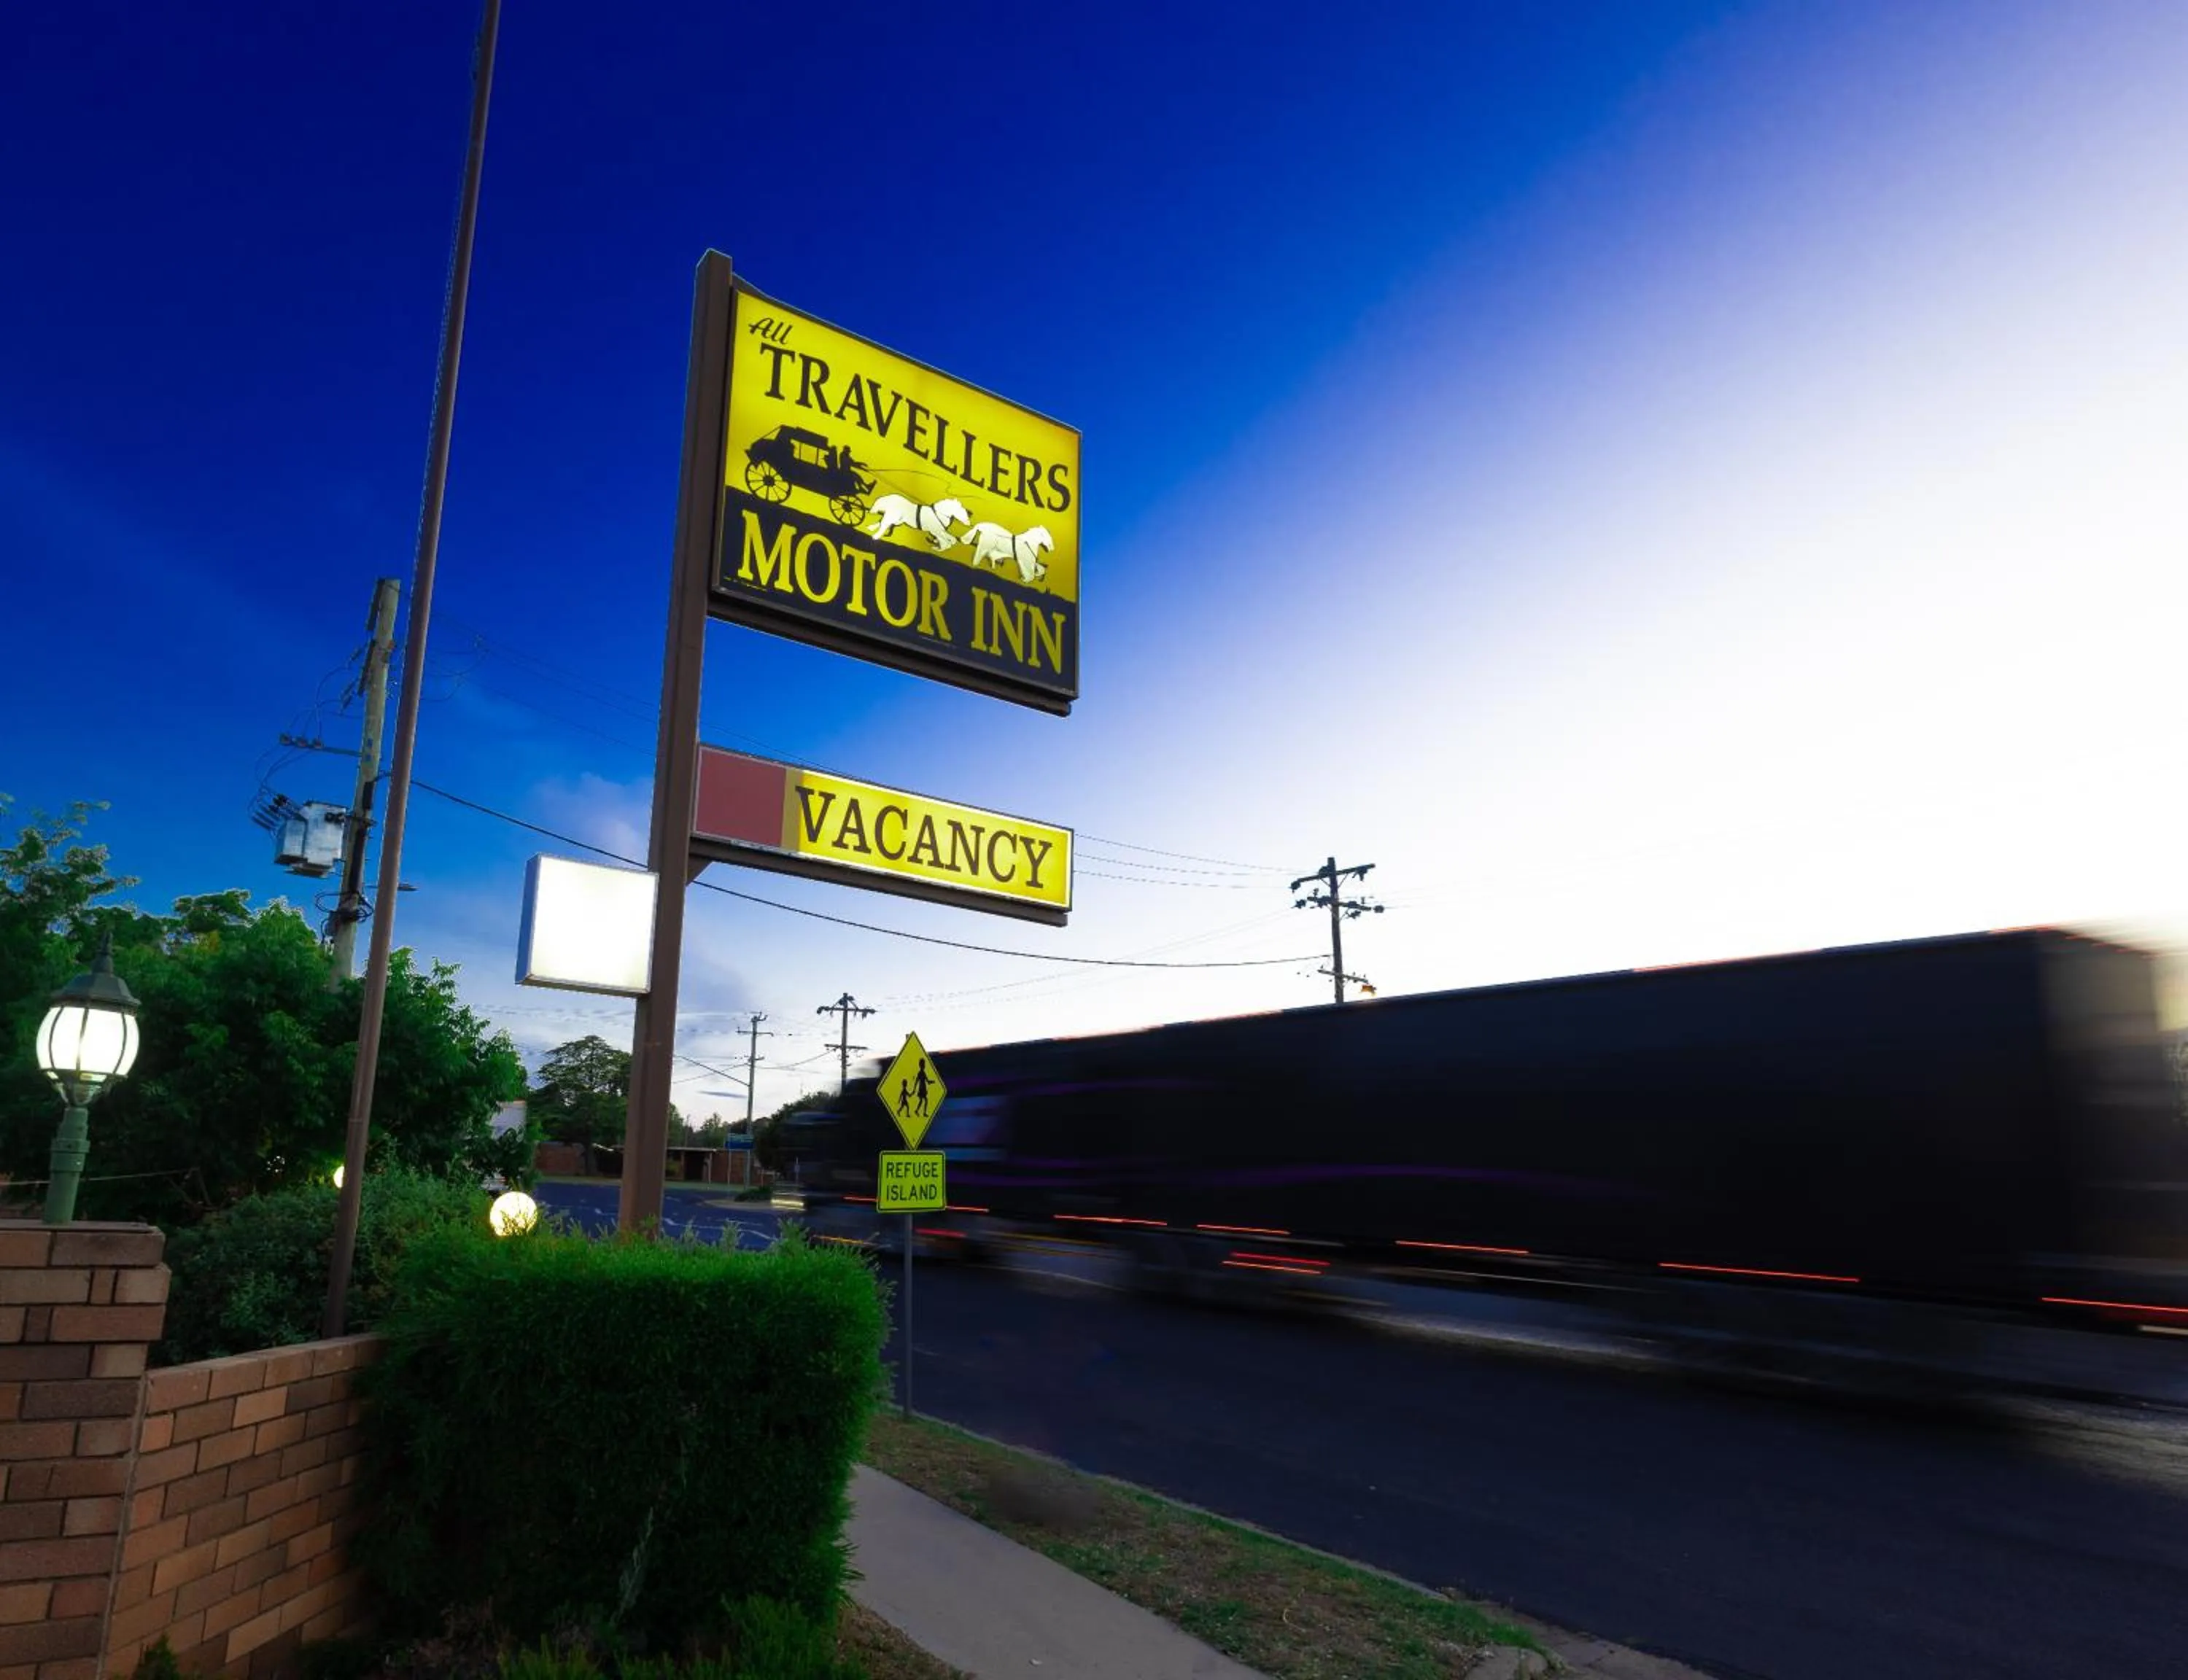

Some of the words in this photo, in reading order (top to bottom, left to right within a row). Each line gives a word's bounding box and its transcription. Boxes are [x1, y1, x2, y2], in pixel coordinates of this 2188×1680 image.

[748, 316, 792, 345] All
[760, 343, 1071, 512] TRAVELLERS
[737, 509, 952, 640] MOTOR
[971, 586, 1065, 674] INN
[796, 785, 1052, 888] VACANCY
[885, 1162, 939, 1178] REFUGE
[886, 1184, 937, 1201] ISLAND
